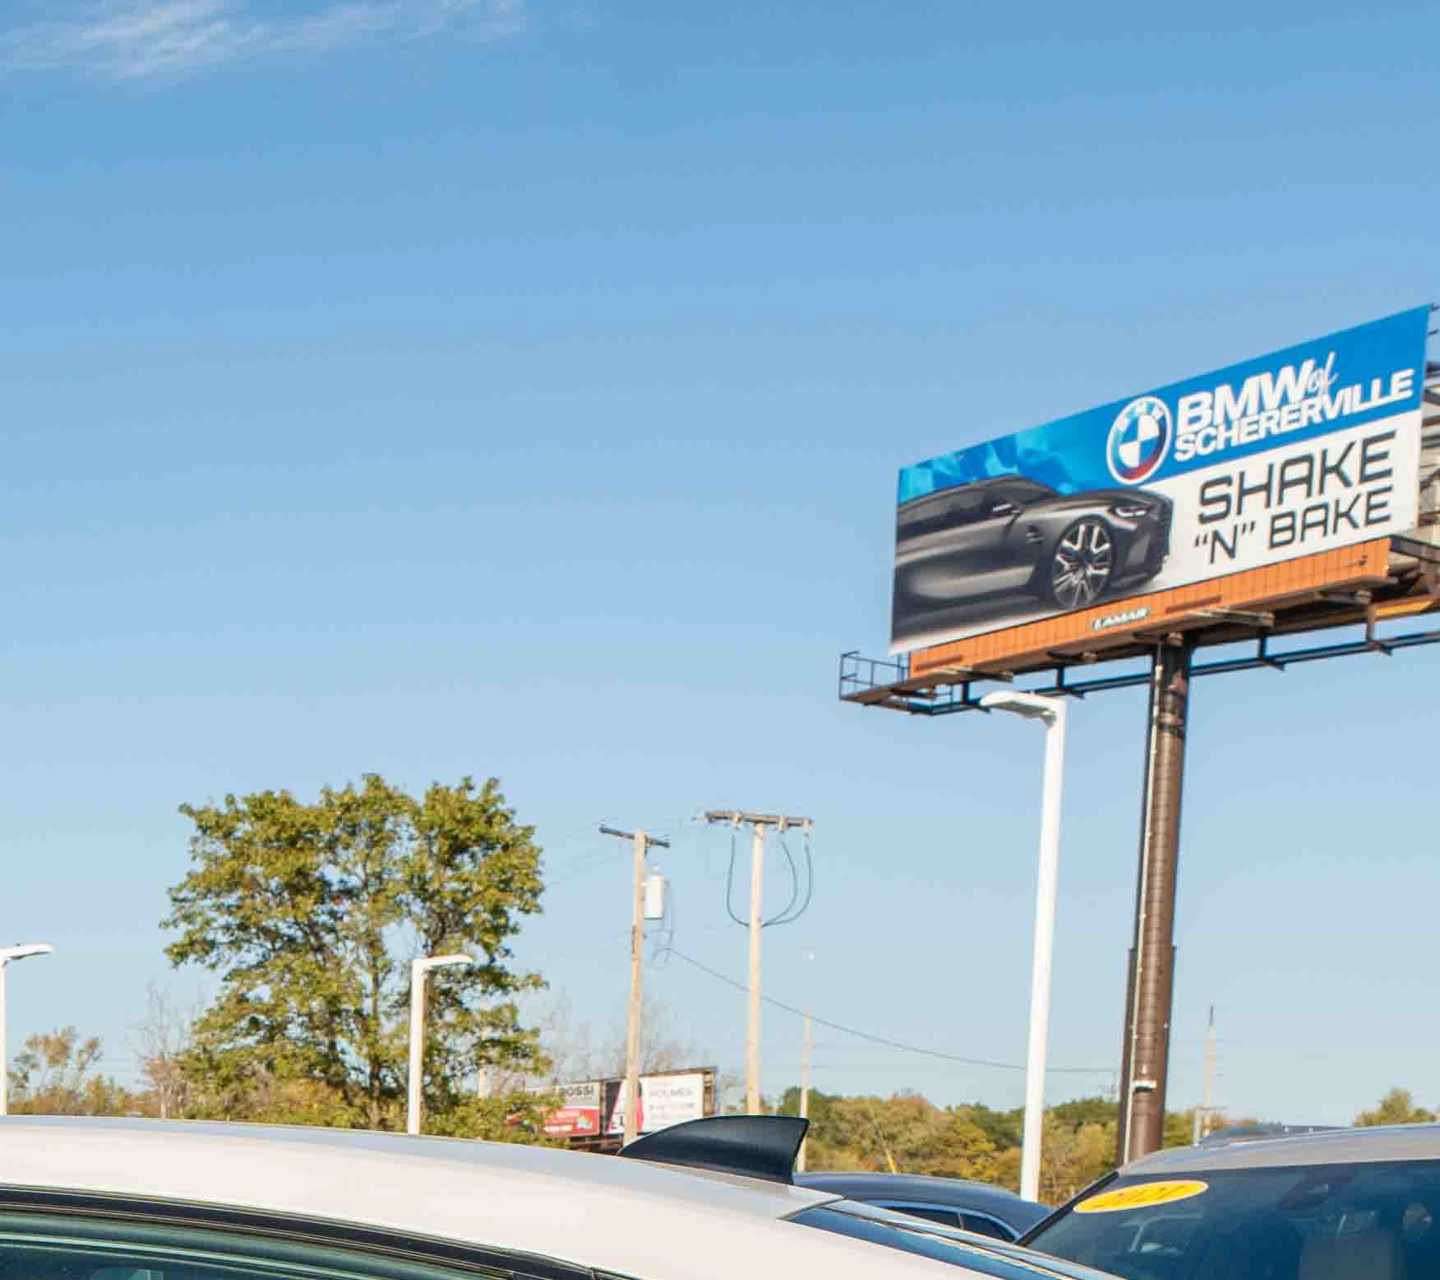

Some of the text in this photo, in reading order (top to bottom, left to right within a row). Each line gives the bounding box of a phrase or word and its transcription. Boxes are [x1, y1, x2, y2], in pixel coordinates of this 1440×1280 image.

[1173, 368, 1415, 462] SCHERERVILLE
[1176, 351, 1339, 434] BMW of
[1198, 429, 1397, 524] SHAKE
[1268, 486, 1393, 550] BAKE
